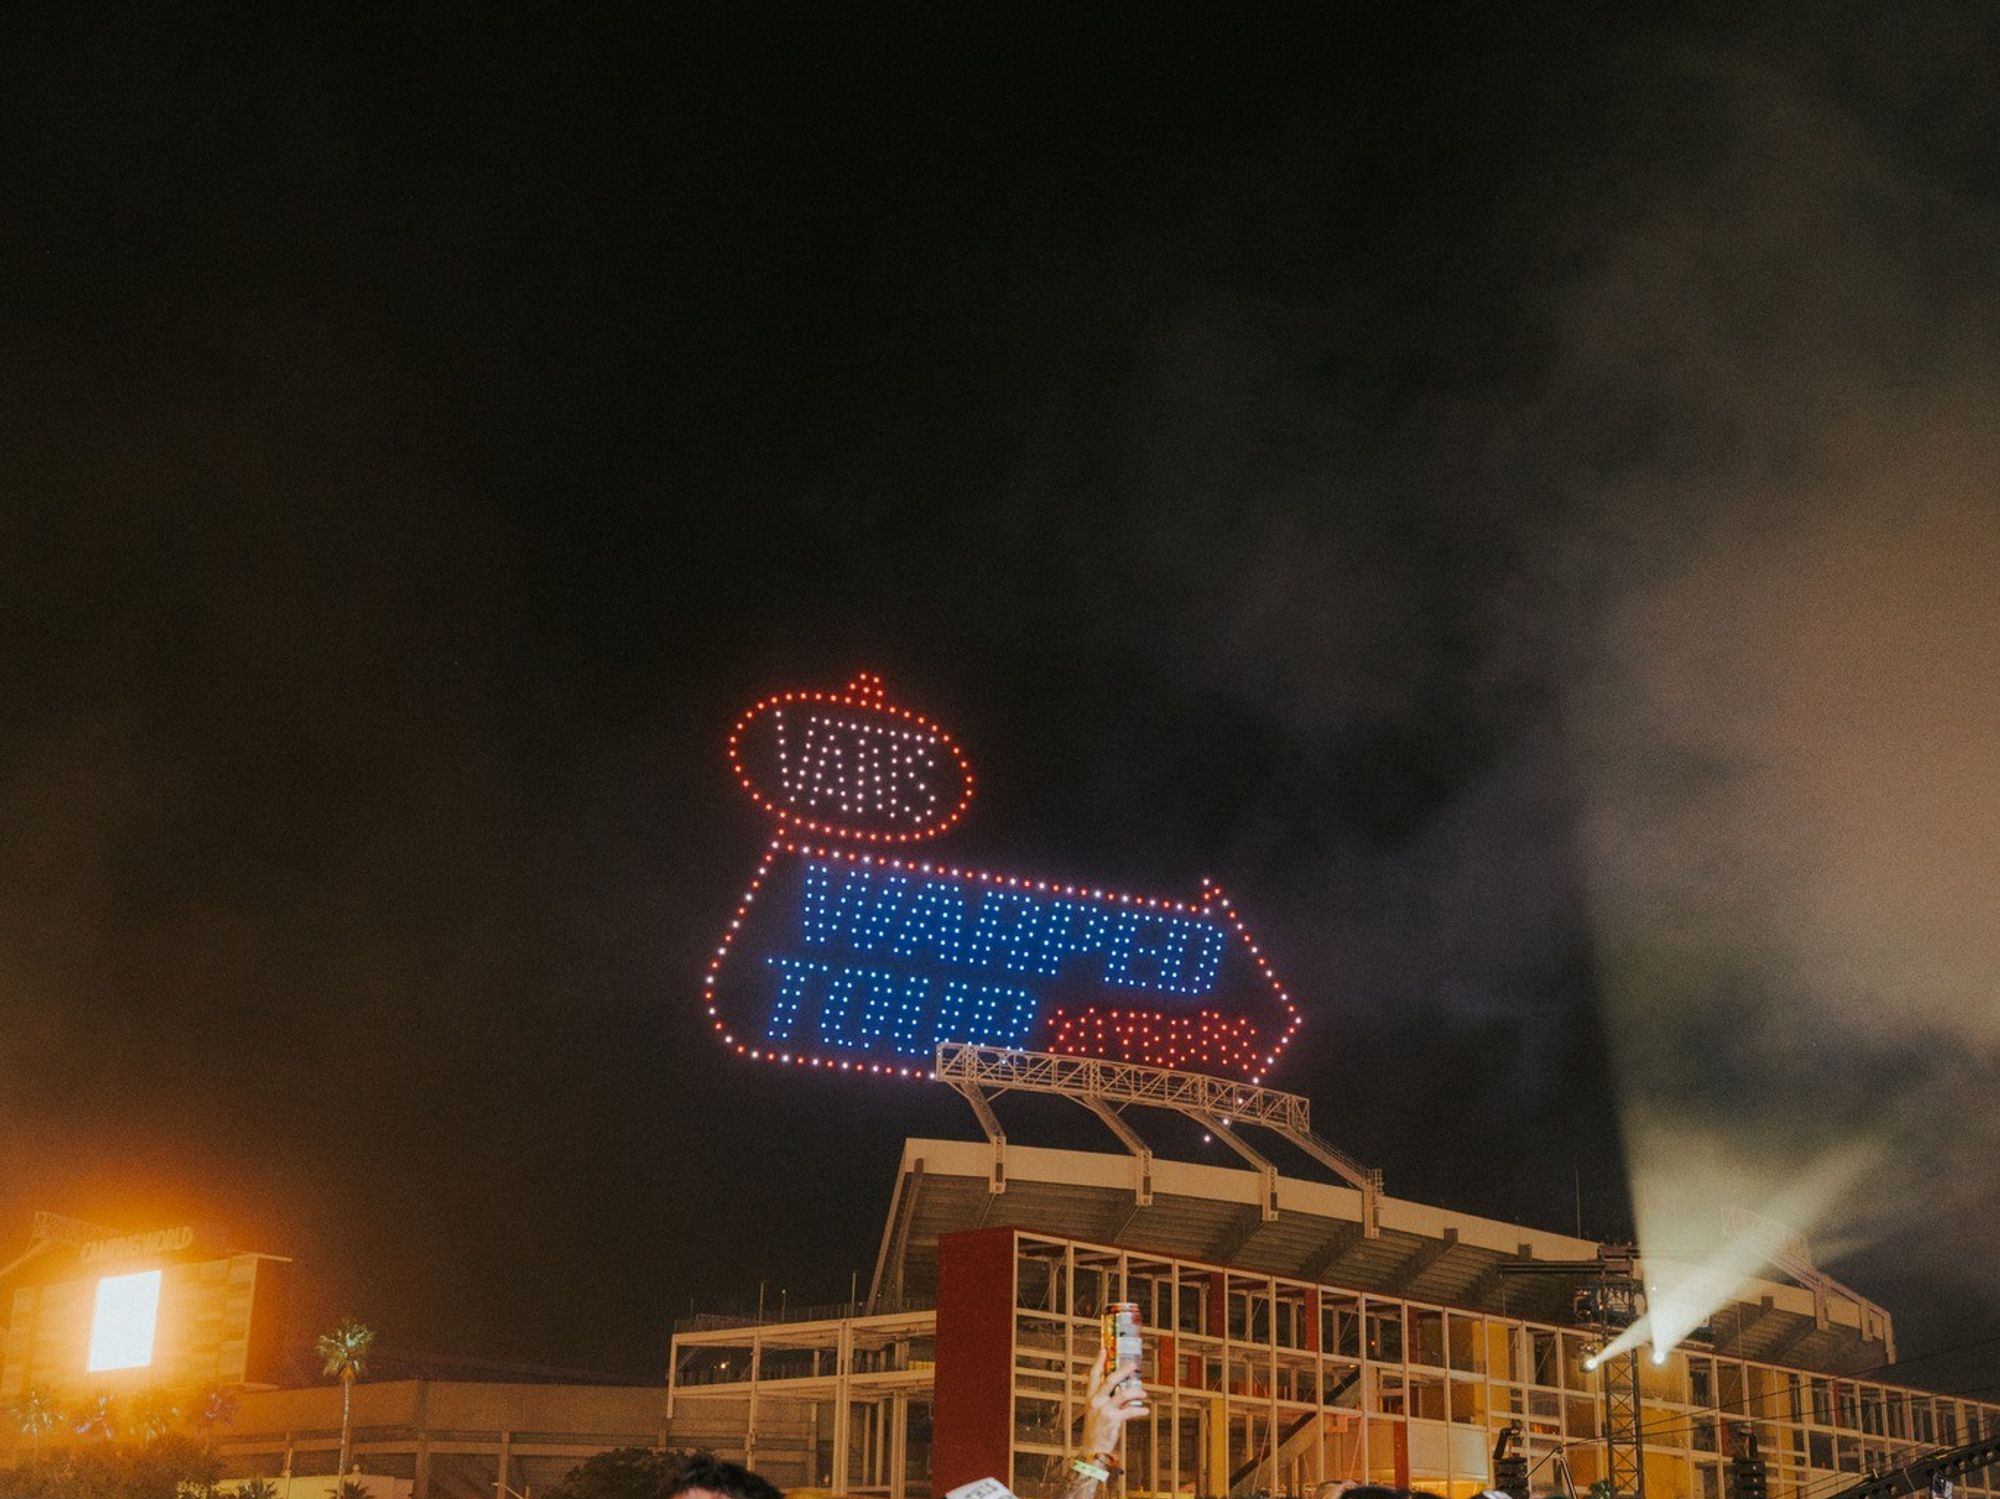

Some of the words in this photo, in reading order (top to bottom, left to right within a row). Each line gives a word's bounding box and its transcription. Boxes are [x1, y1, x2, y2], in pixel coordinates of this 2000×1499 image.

[775, 710, 936, 822] VANS
[803, 864, 1223, 994] WARPED
[767, 957, 1037, 1065] TOUR
[142, 1226, 194, 1257] WORLD
